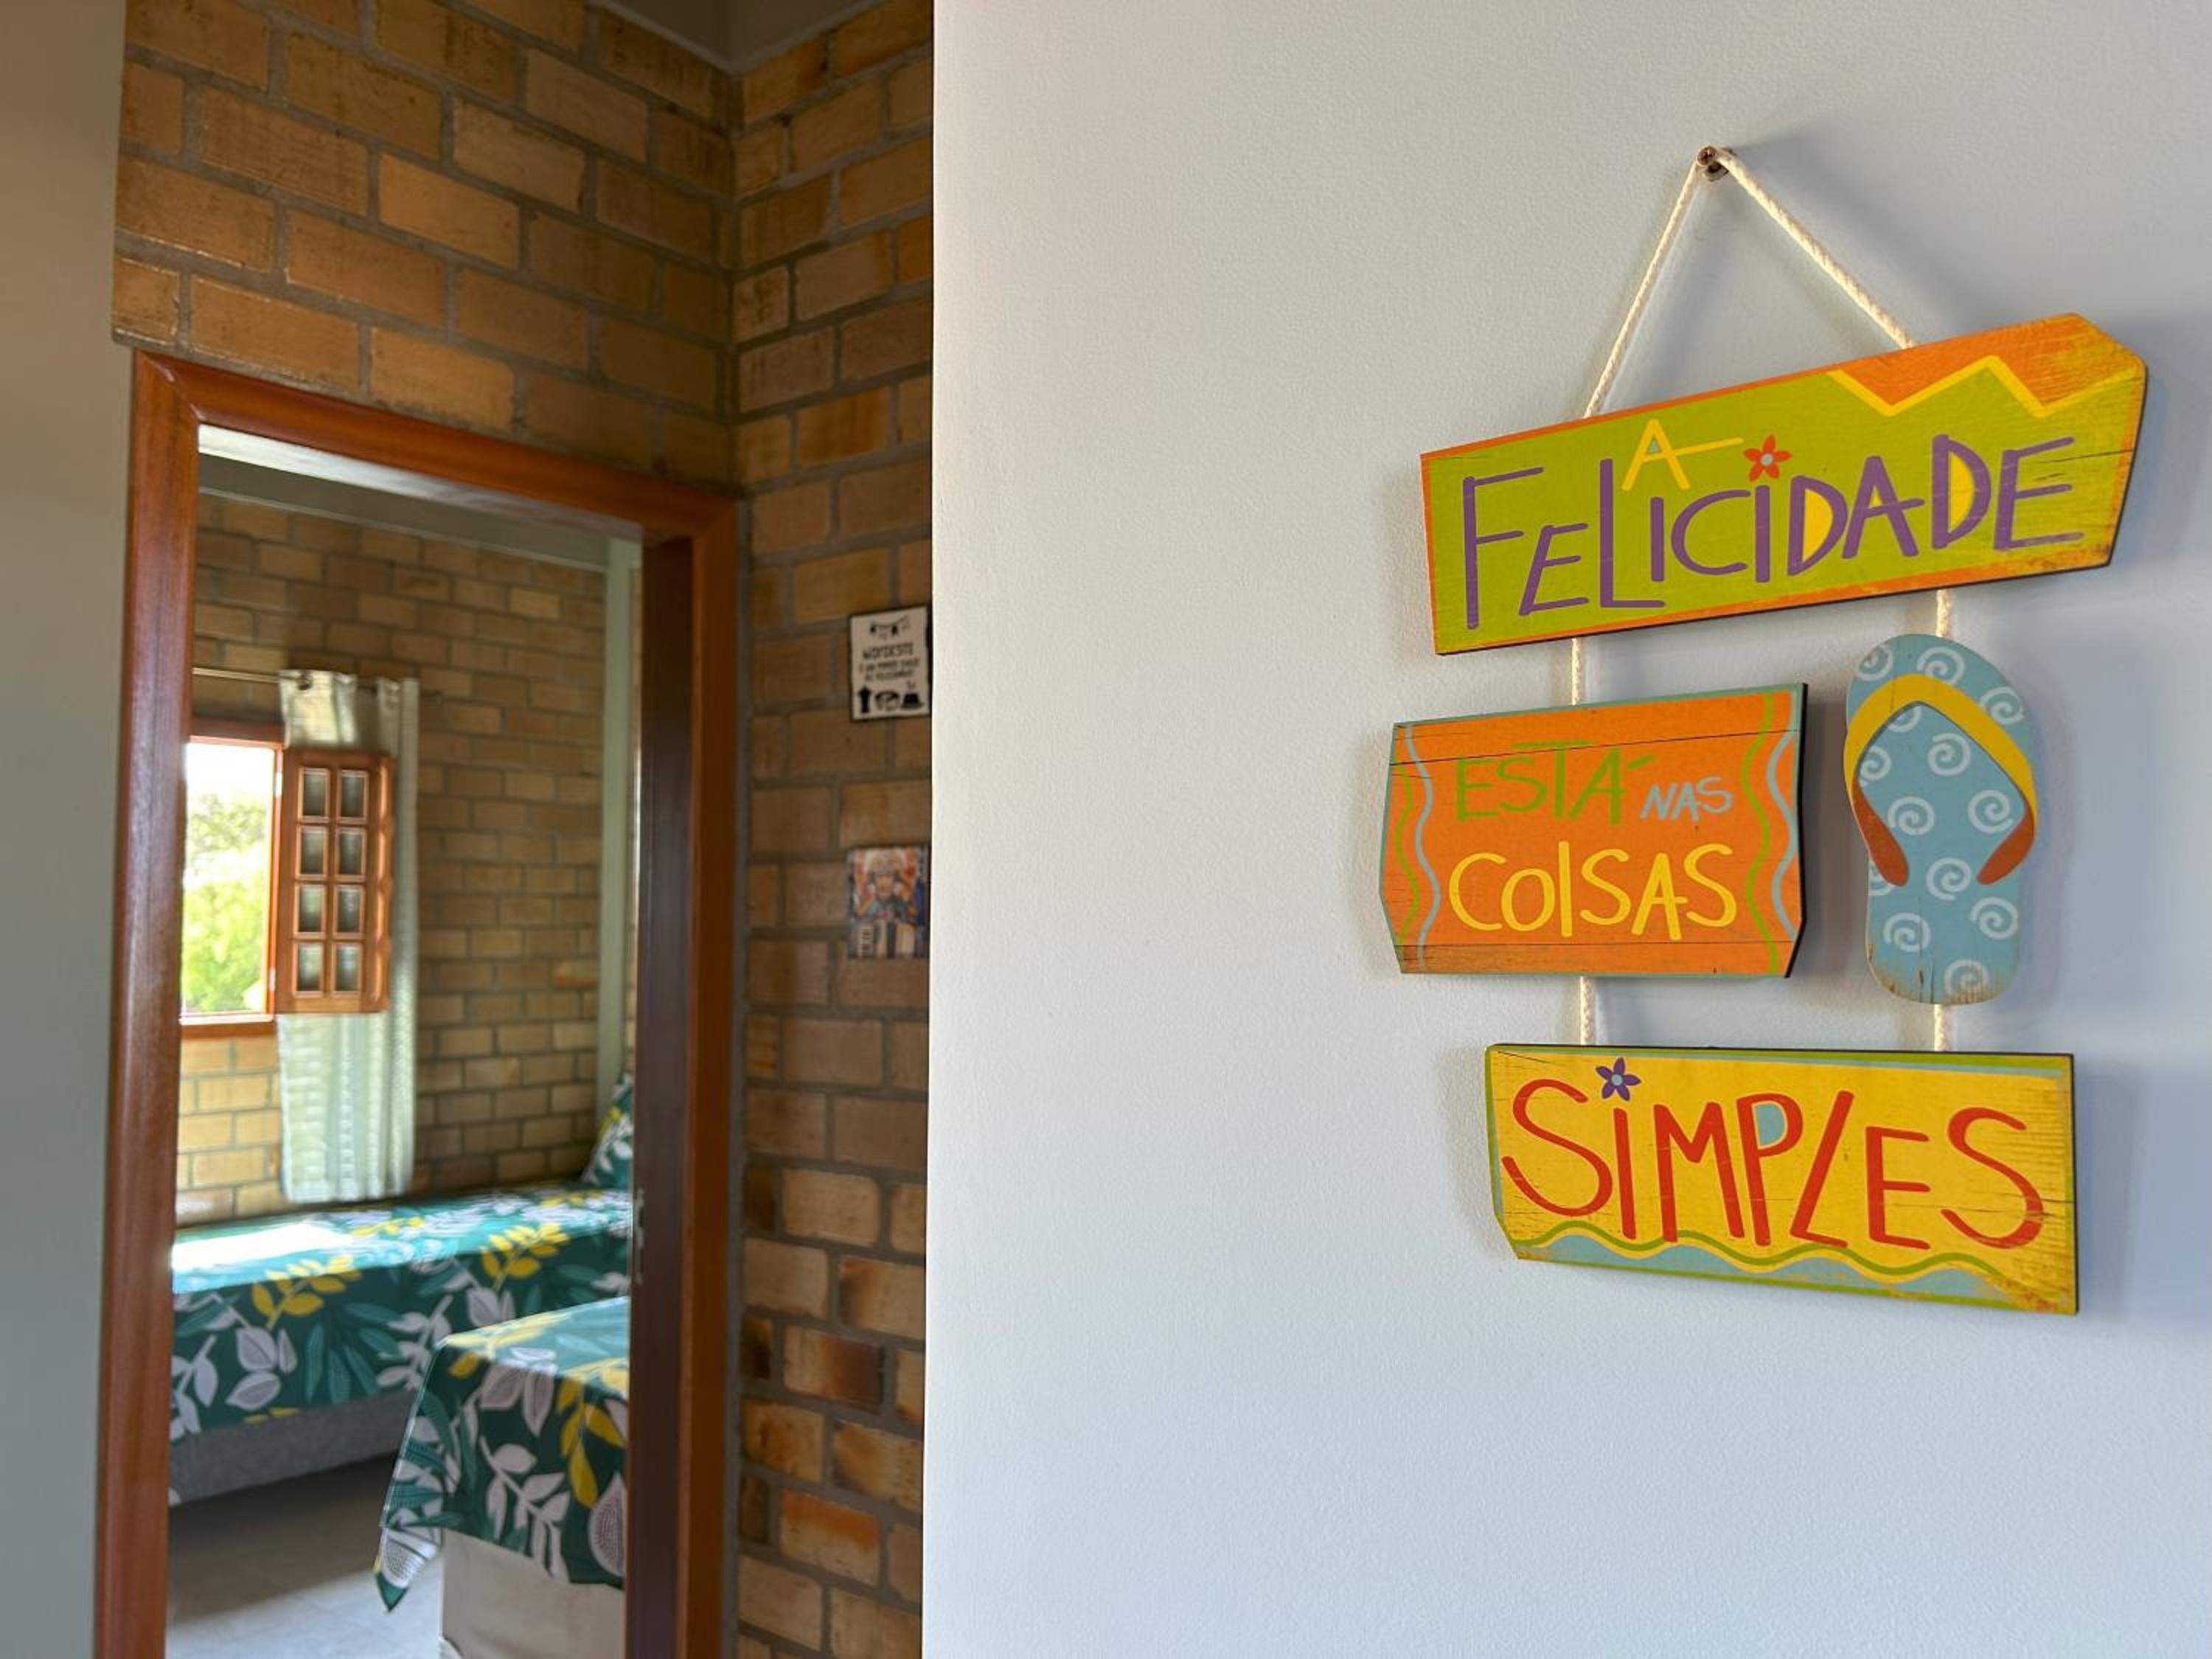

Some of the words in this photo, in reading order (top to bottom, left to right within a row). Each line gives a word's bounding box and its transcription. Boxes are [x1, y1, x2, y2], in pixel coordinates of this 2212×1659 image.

[1622, 419, 1744, 490] A
[1463, 434, 2084, 629] FELICIDADE
[1639, 776, 1733, 821] NAS
[1449, 841, 1738, 941] COISAS
